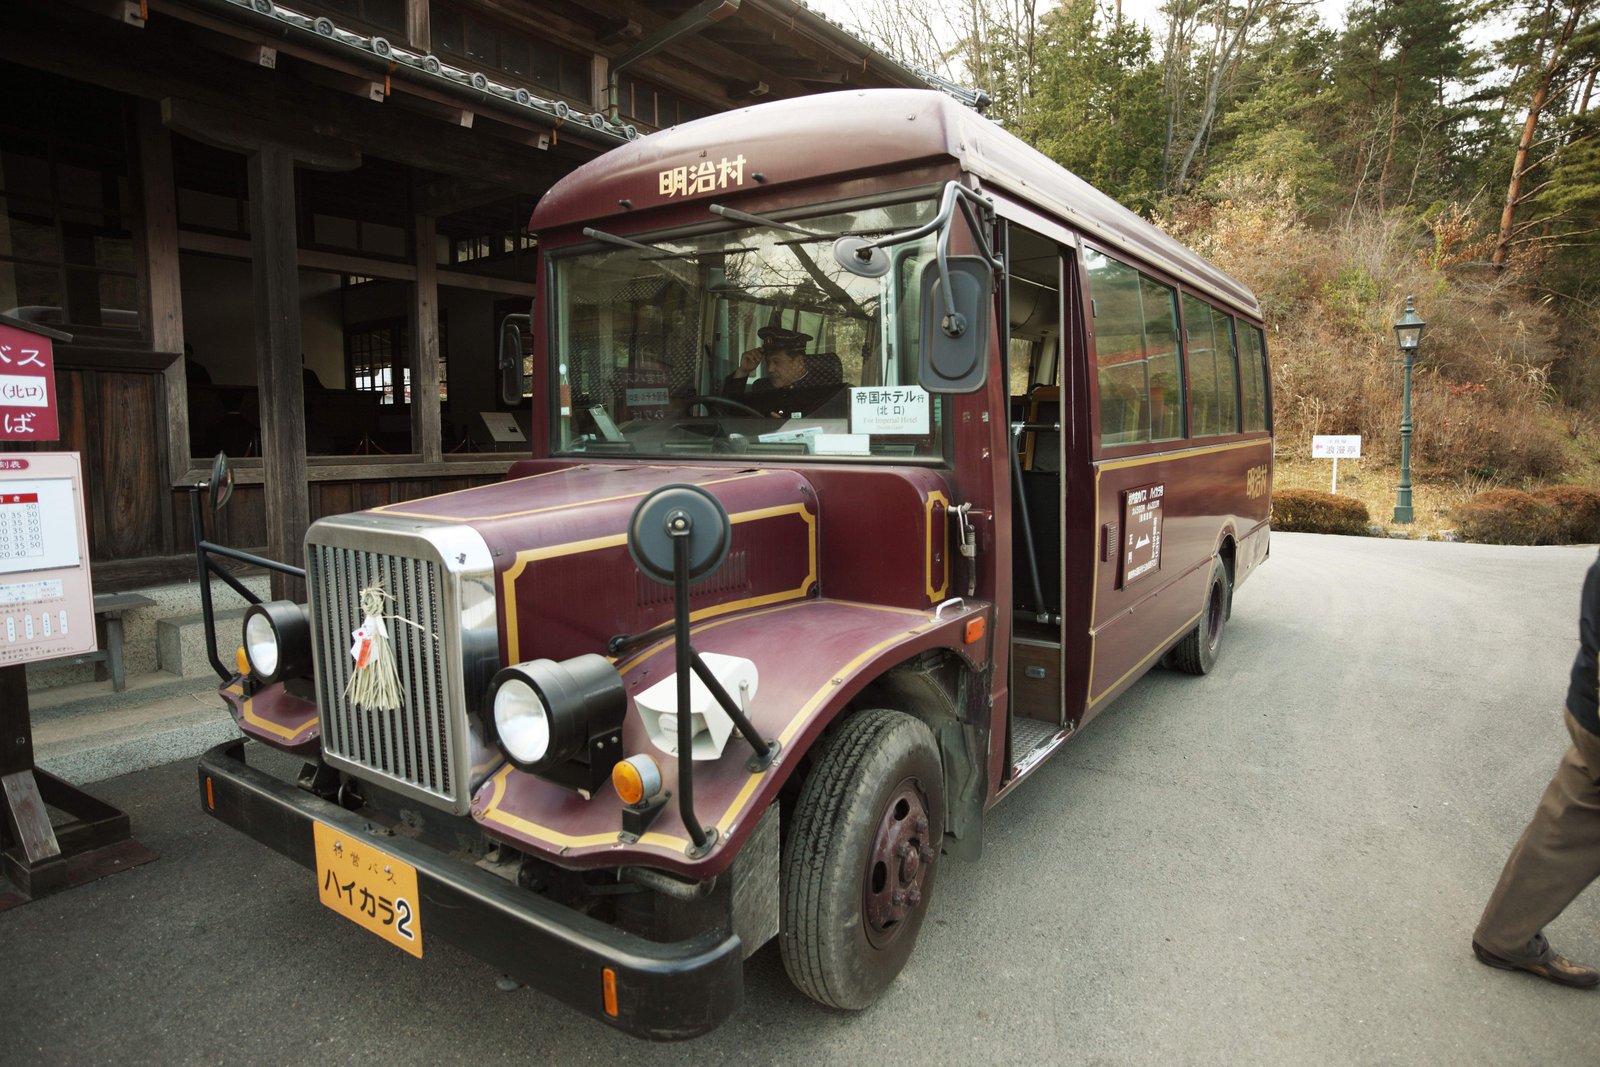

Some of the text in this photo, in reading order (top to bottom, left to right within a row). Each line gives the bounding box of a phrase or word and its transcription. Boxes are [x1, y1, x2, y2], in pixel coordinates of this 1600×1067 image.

[659, 154, 747, 198] 明治村
[856, 390, 924, 405] 帝国ホテル行
[875, 416, 900, 425] Imperial
[901, 416, 918, 424] Hotel
[1246, 463, 1268, 500] 明治村
[324, 868, 415, 941] ハイカラ2
